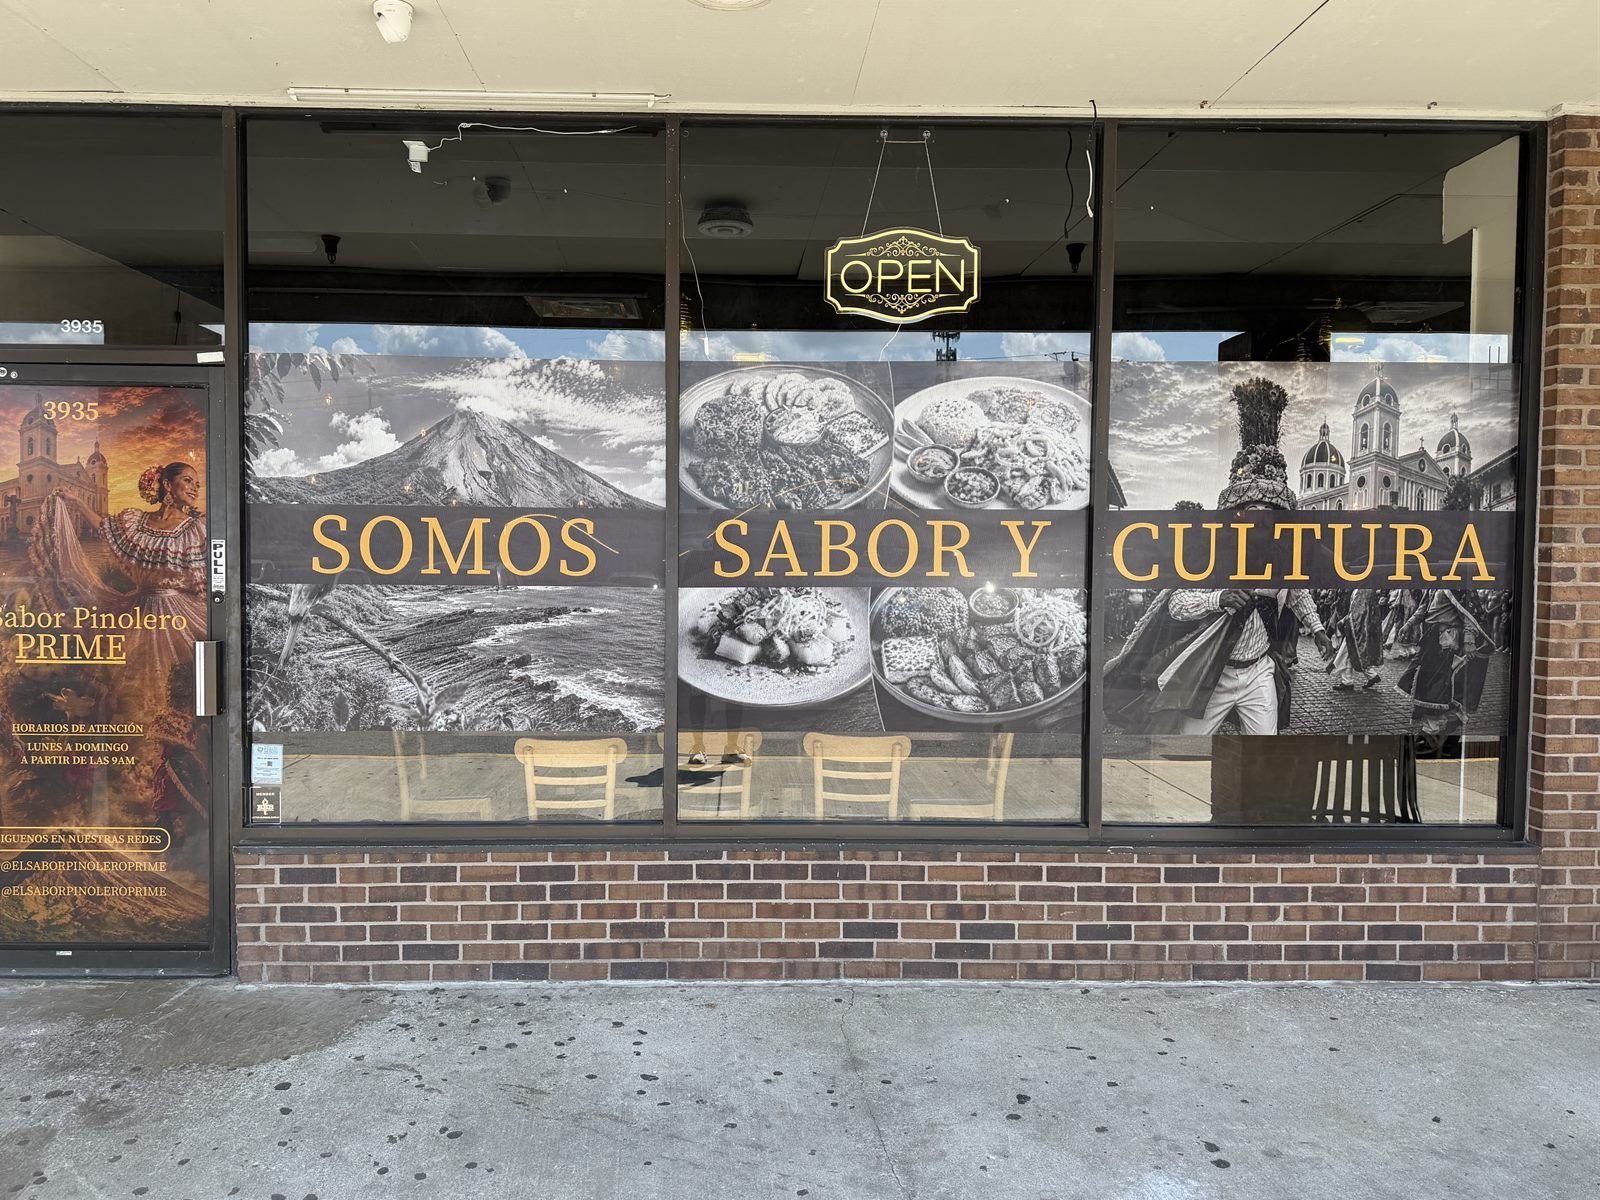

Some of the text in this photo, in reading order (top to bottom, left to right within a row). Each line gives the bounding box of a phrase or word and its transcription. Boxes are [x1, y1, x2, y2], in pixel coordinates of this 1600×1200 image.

[840, 258, 965, 294] OPEN
[60, 319, 104, 334] 3935
[43, 401, 99, 421] 3935
[311, 514, 1496, 582] SOMOS SABOR Y CULTURA
[212, 543, 224, 575] PULL
[0, 604, 187, 631] abor Pinolero
[15, 633, 126, 660] PRIME
[12, 721, 144, 733] HORARIOS DE ATENCIÓN
[27, 742, 129, 752] LUNES A DOMINGO
[20, 756, 136, 765] A PARTIR DE LAS 9AM
[0, 834, 162, 844] IGUENOS EN NUESTRAS REDES
[0, 860, 167, 873] @ELSABORPINOLEROPRIME
[1, 885, 167, 898] @ELSABORPINOLEROPRIME
